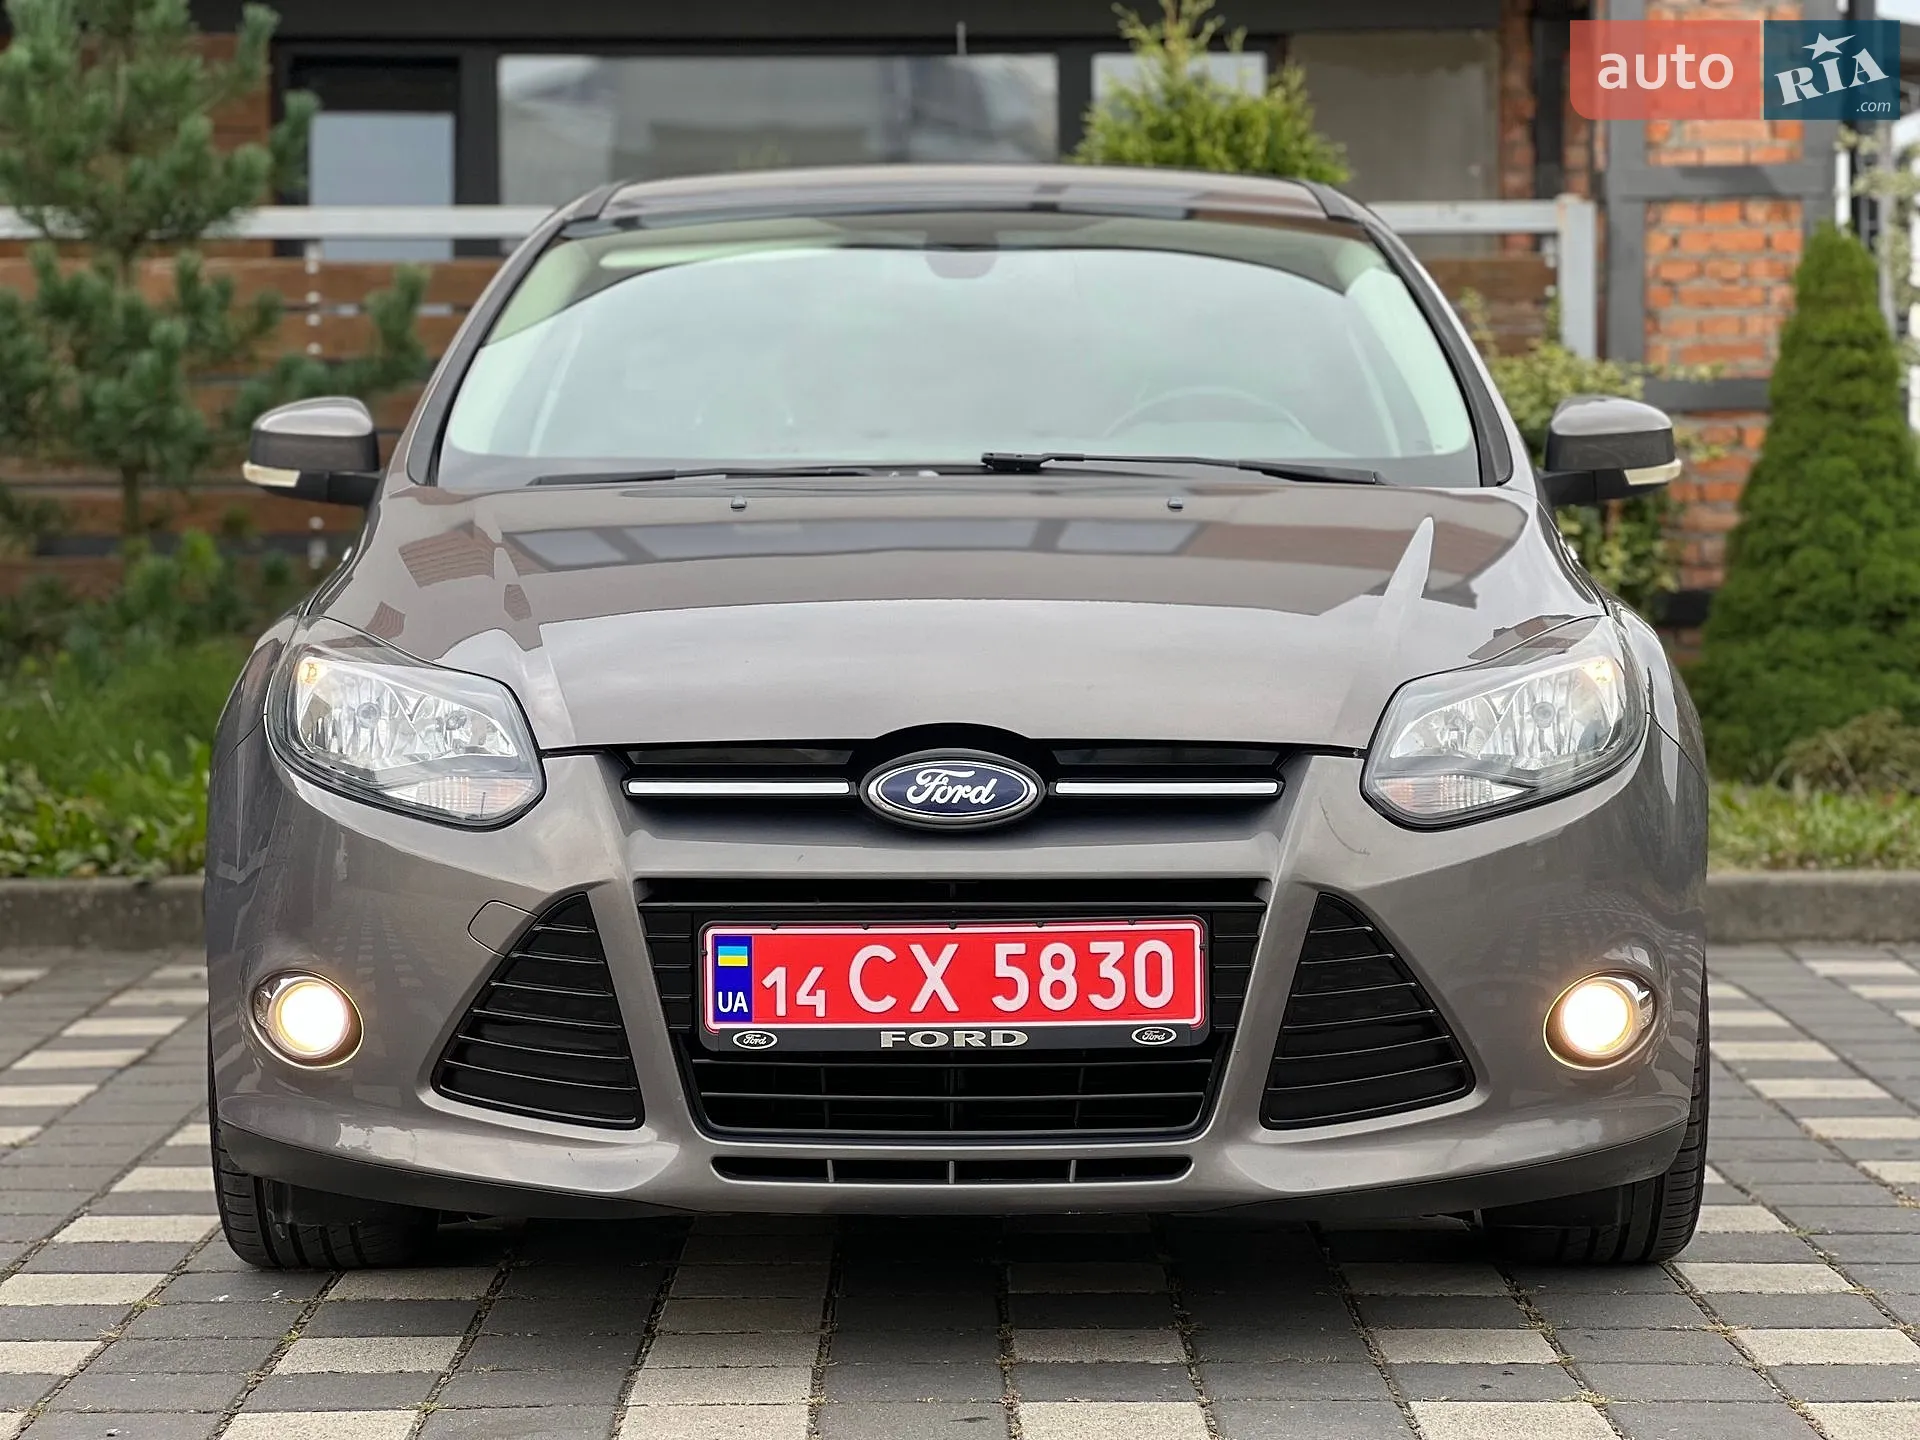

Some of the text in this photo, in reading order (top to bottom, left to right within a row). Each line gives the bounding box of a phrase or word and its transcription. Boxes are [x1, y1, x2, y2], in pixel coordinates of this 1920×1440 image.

[906, 768, 998, 804] Ford
[761, 939, 1175, 1018] 14 CX 5830
[717, 991, 749, 1013] UA
[880, 1030, 1029, 1049] FORD
